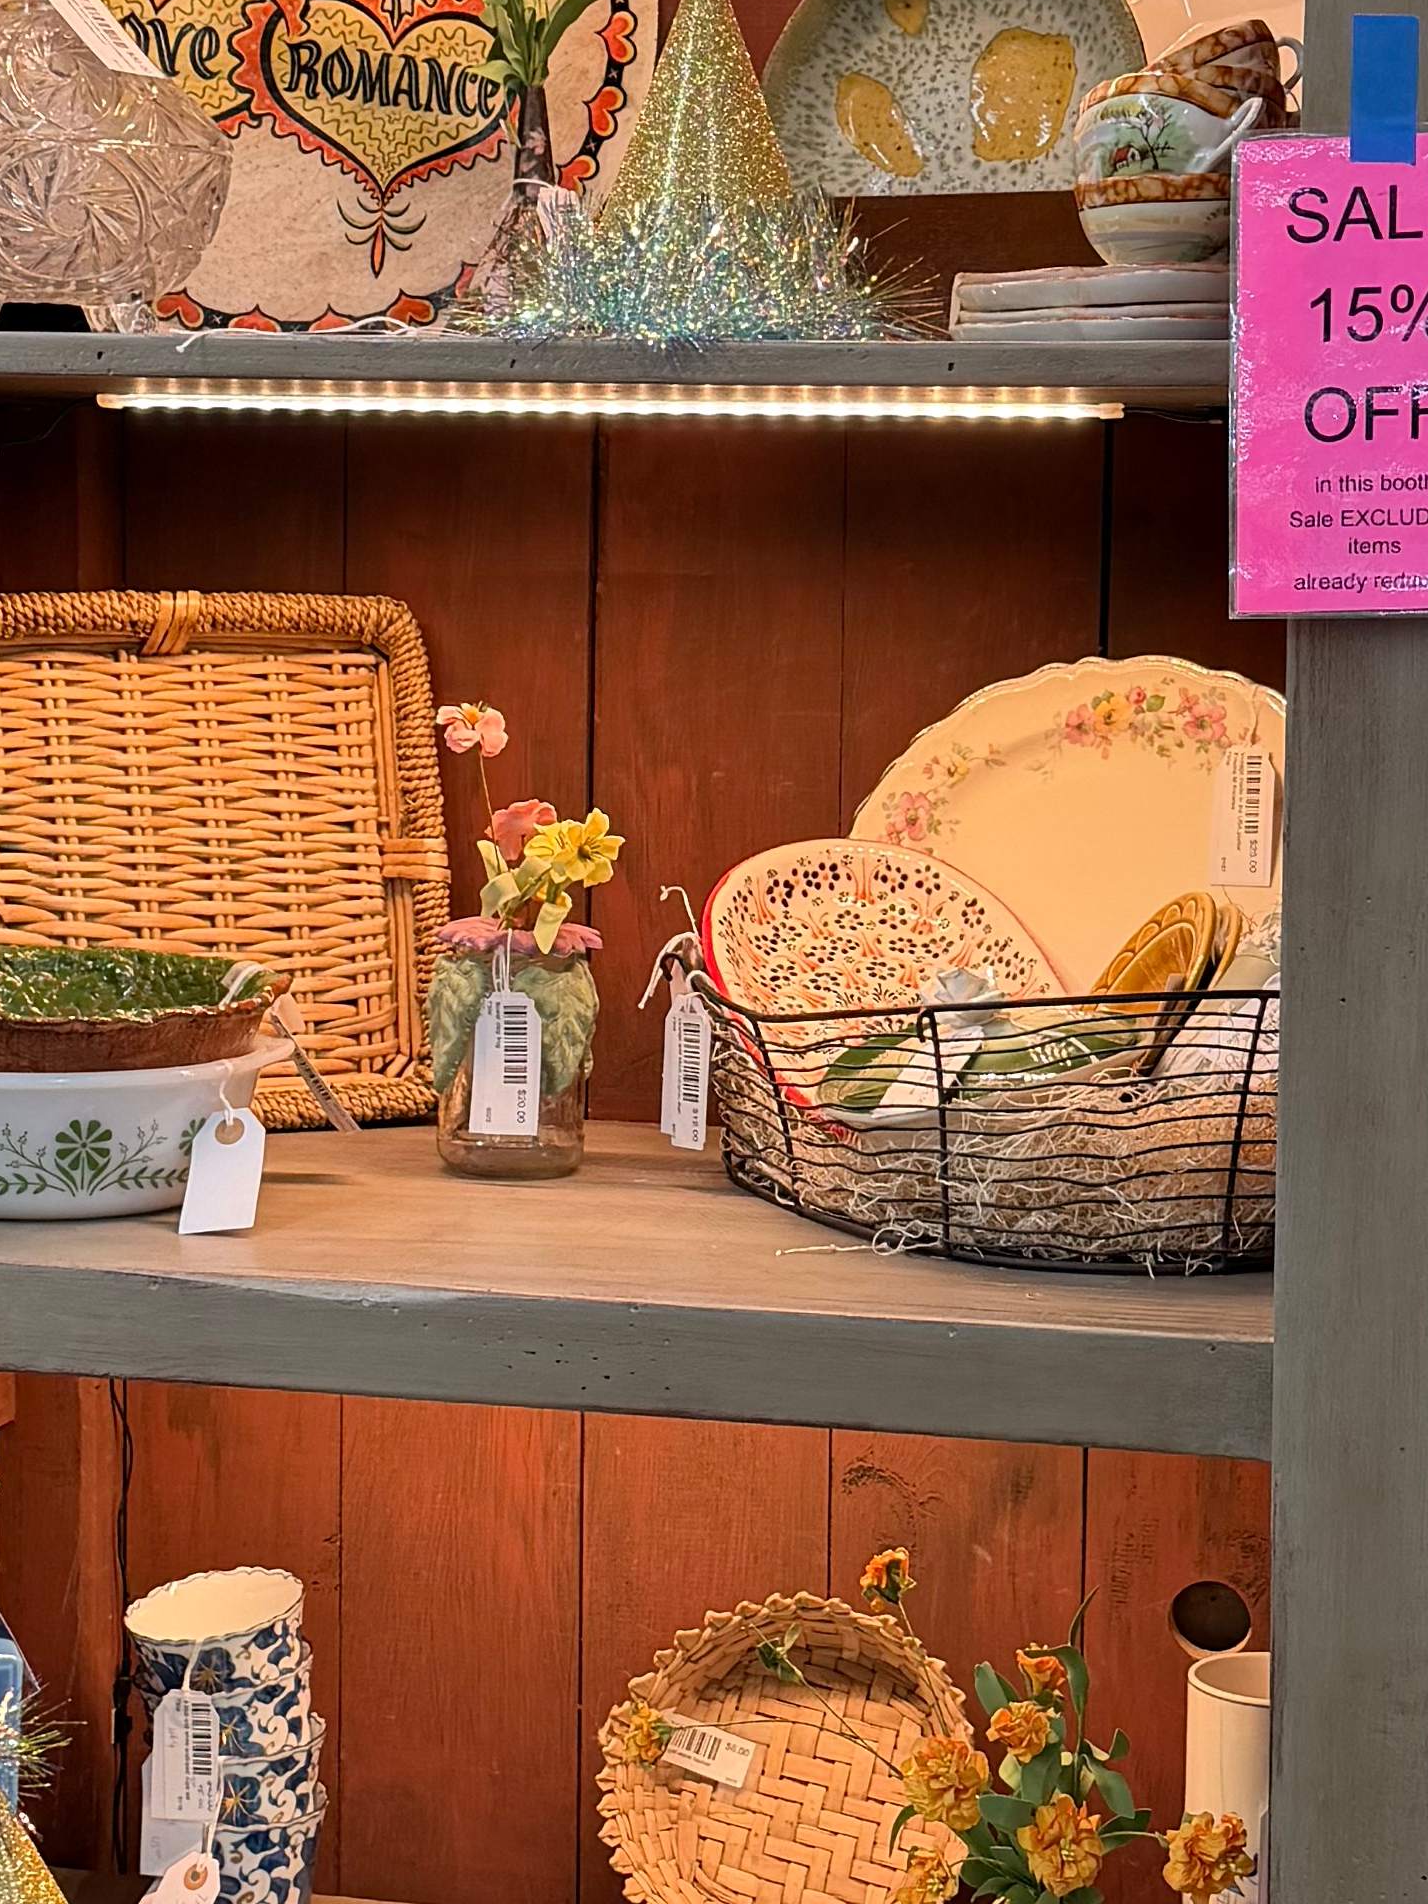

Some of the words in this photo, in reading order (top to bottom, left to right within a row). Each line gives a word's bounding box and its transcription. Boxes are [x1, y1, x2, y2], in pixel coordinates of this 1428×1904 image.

[1315, 476, 1332, 493] in
[1338, 475, 1373, 493] this
[1289, 510, 1334, 528] Sale
[1348, 537, 1402, 555] items
[1293, 573, 1368, 593] already
[516, 1088, 527, 1124] $20.00
